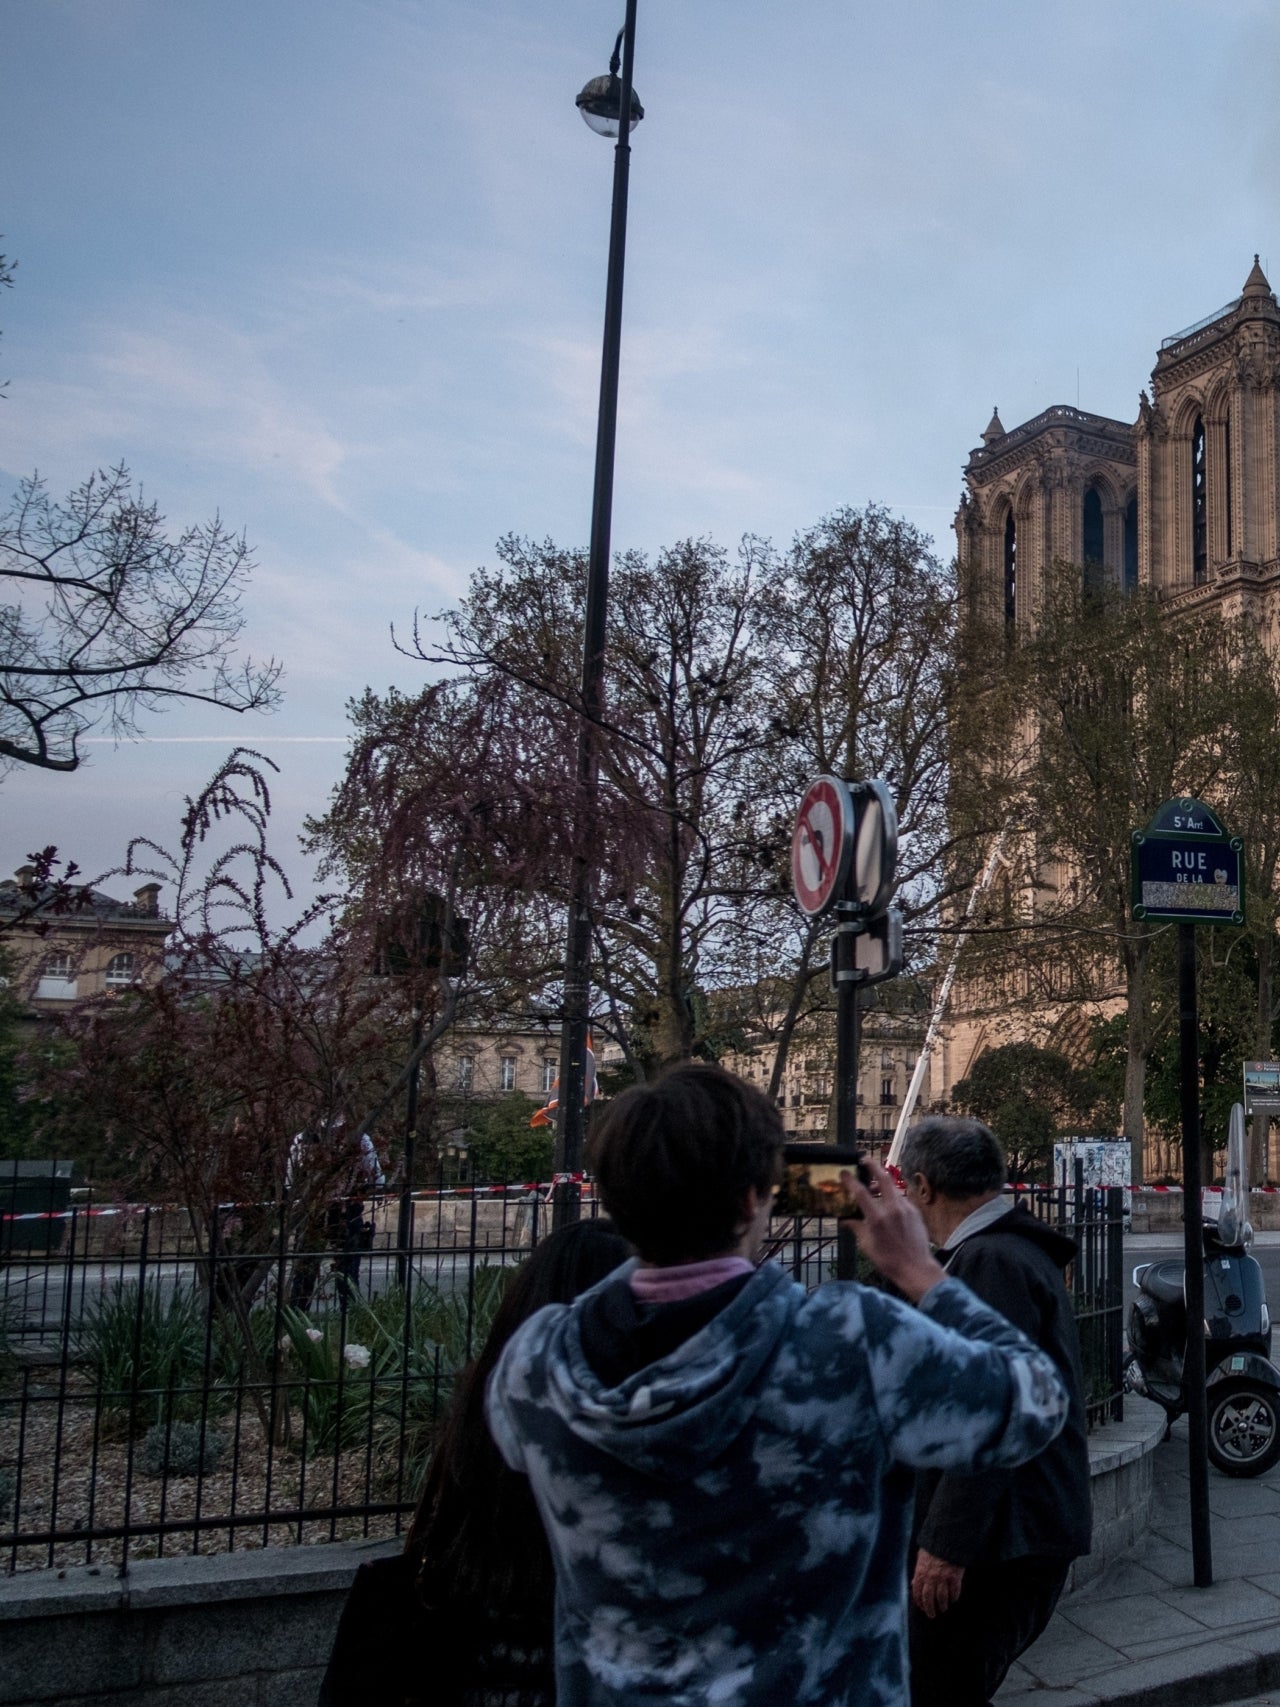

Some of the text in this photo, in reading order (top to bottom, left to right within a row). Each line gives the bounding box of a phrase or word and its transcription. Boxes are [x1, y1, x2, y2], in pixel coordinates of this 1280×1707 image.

[1172, 851, 1207, 869] RUE
[1177, 873, 1203, 884] DE LA
